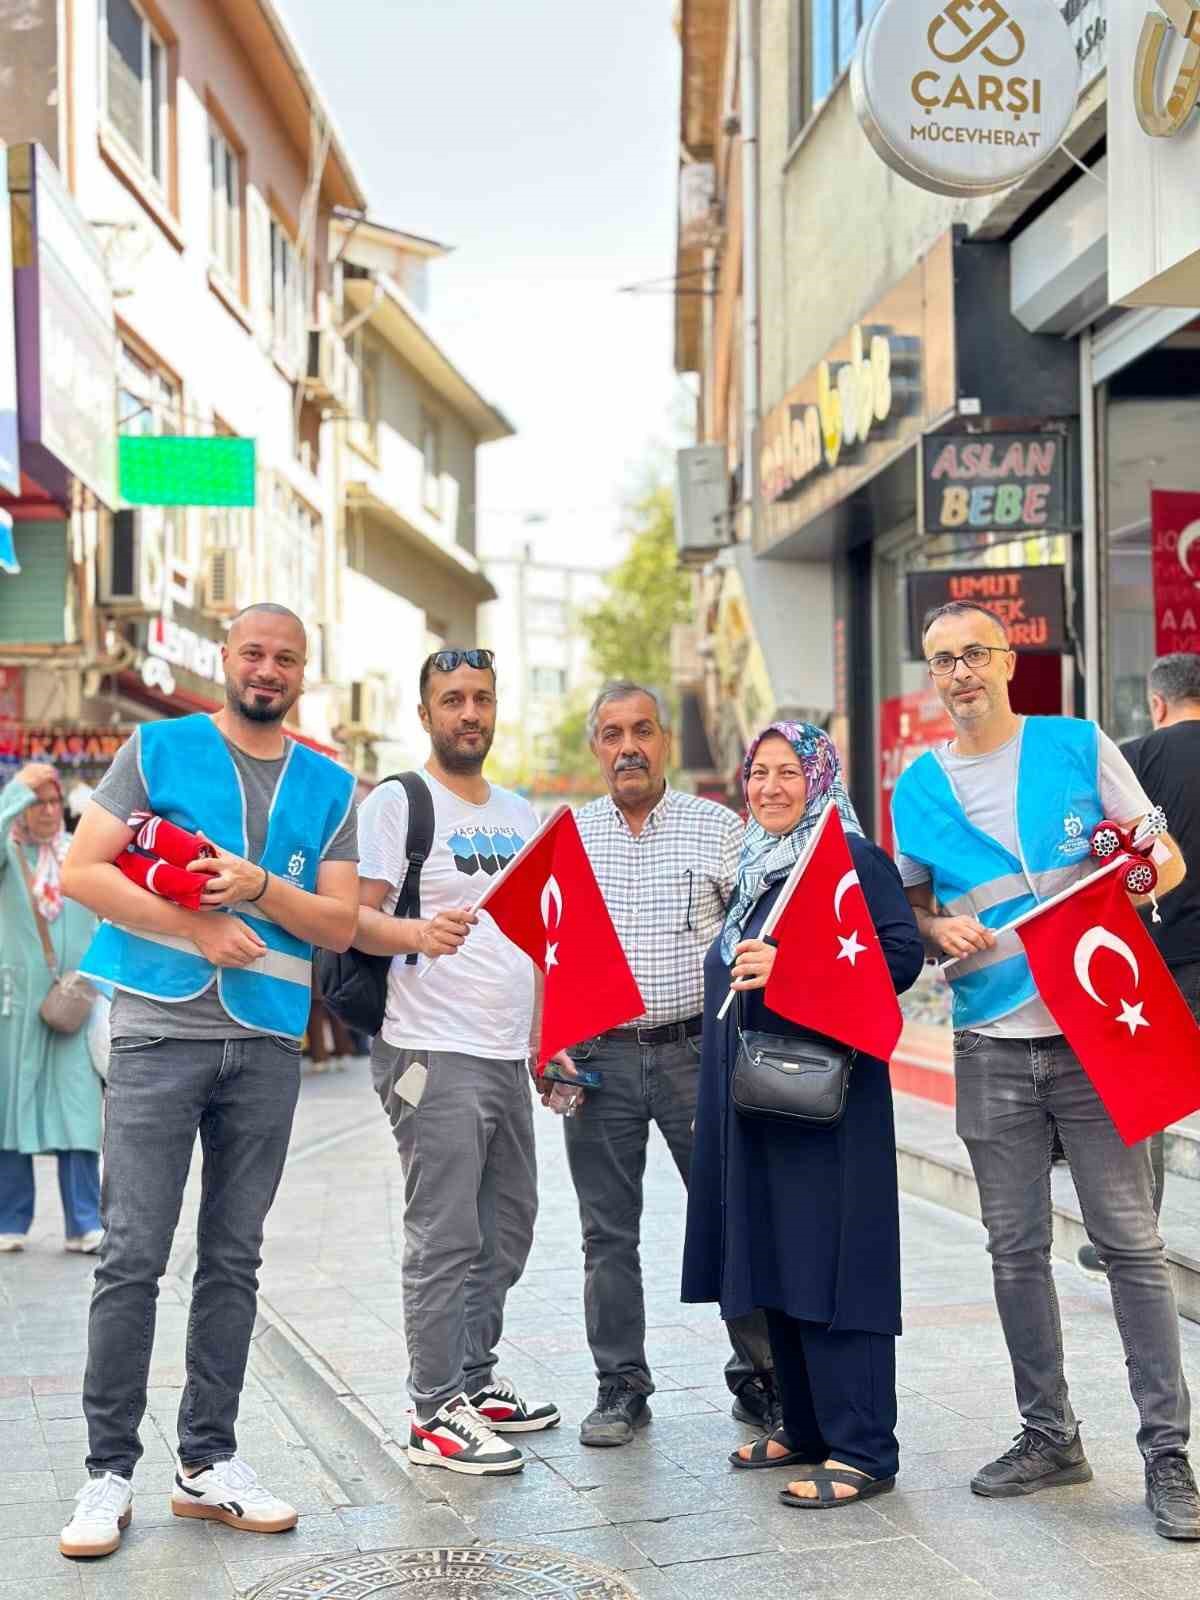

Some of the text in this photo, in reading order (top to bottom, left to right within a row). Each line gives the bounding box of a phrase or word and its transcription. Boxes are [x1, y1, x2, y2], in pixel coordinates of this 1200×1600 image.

[911, 70, 1041, 121] ÇARŞI
[910, 121, 1041, 148] MÜCEVHERAT
[931, 440, 1056, 480] ASLAN
[940, 484, 1051, 527] BEBE
[949, 573, 1022, 599] UMUT
